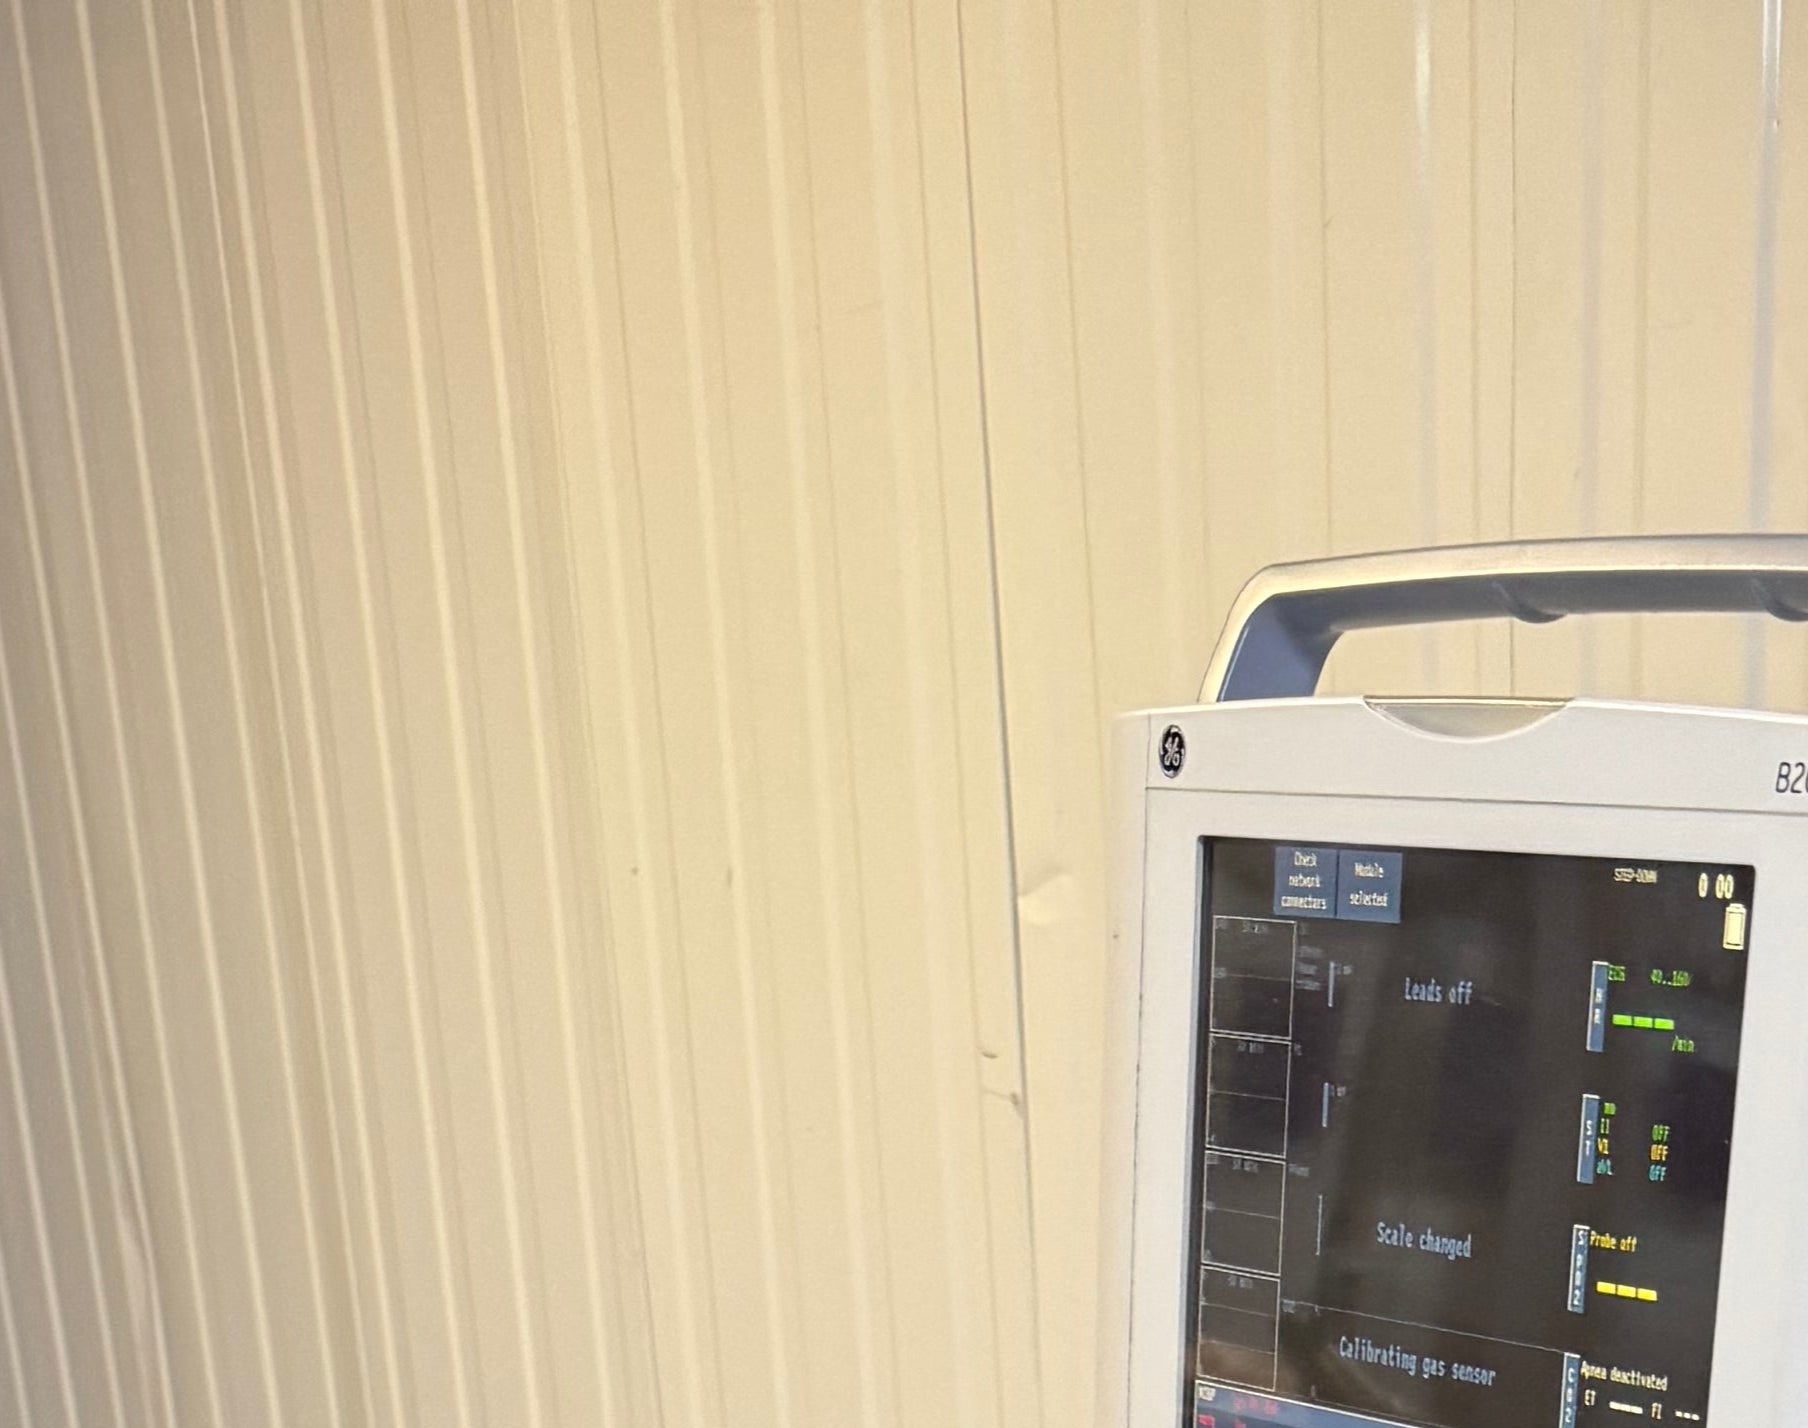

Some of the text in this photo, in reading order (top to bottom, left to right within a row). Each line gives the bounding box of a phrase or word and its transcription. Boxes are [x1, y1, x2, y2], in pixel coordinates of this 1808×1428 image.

[1405, 977, 1473, 1005] Leads off
[1376, 1221, 1472, 1260] Scale changed
[1590, 1230, 1637, 1252] Probe off
[1339, 1336, 1496, 1386] Calibrating gas sensor
[1581, 1361, 1668, 1391] Apnea deactivated
